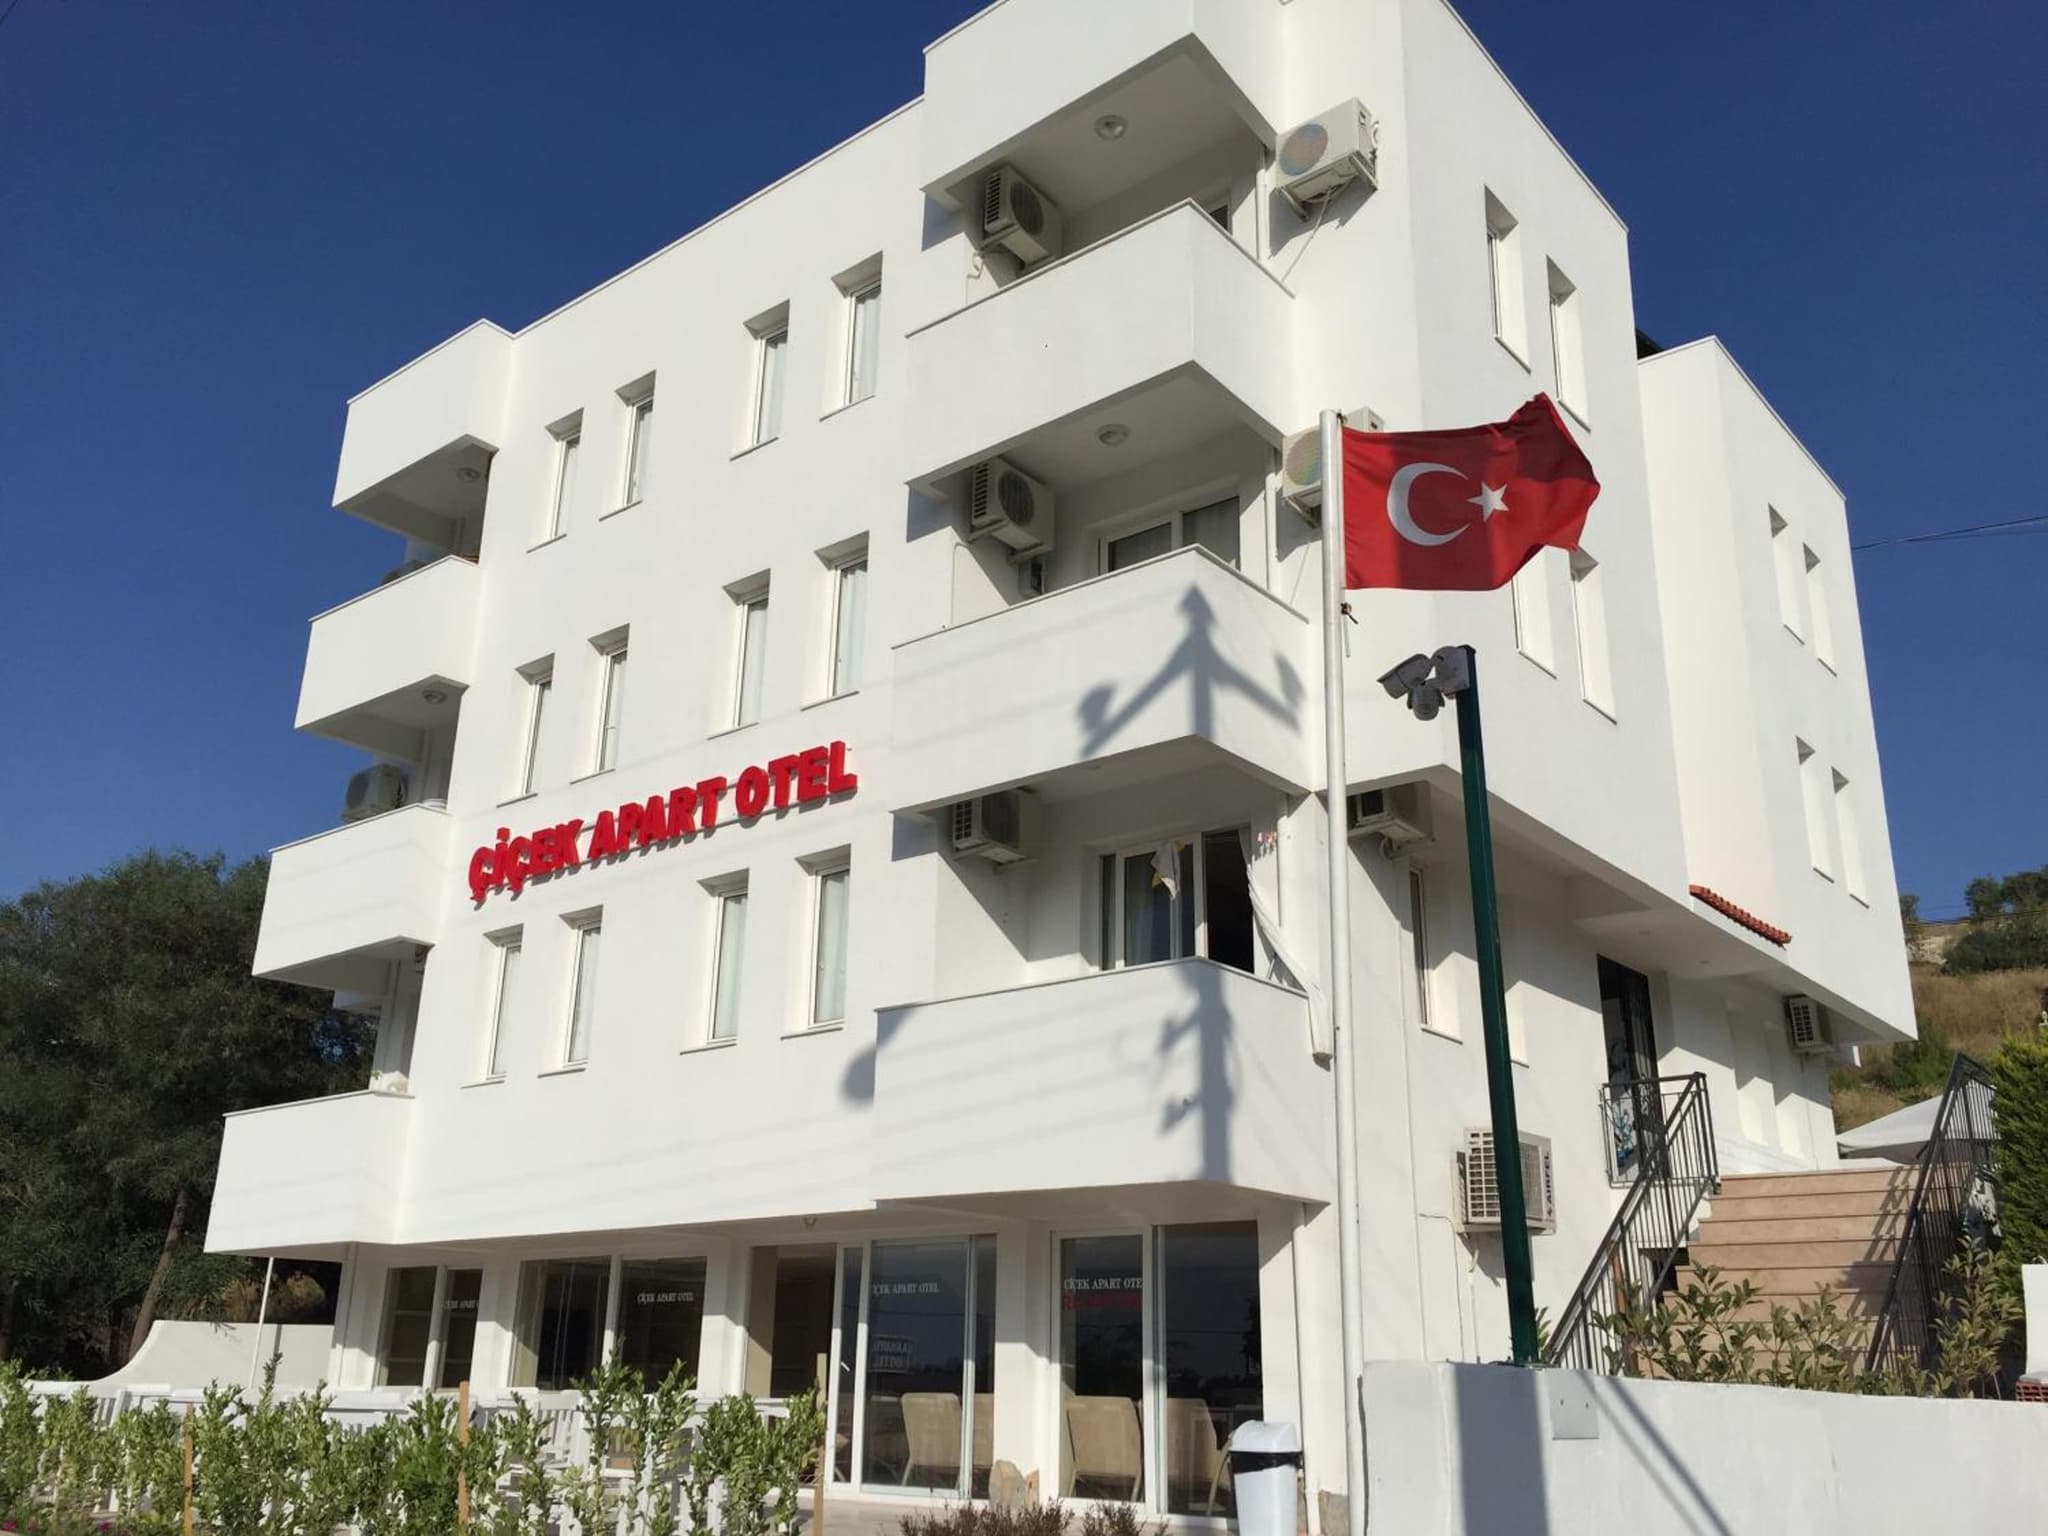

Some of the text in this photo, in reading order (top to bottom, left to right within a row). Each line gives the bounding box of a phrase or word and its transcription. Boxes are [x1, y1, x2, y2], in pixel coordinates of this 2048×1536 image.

[468, 740, 858, 902] ÇİÇEK APART OTEL
[1092, 1278, 1121, 1289] APART
[1123, 1277, 1143, 1289] OTE
